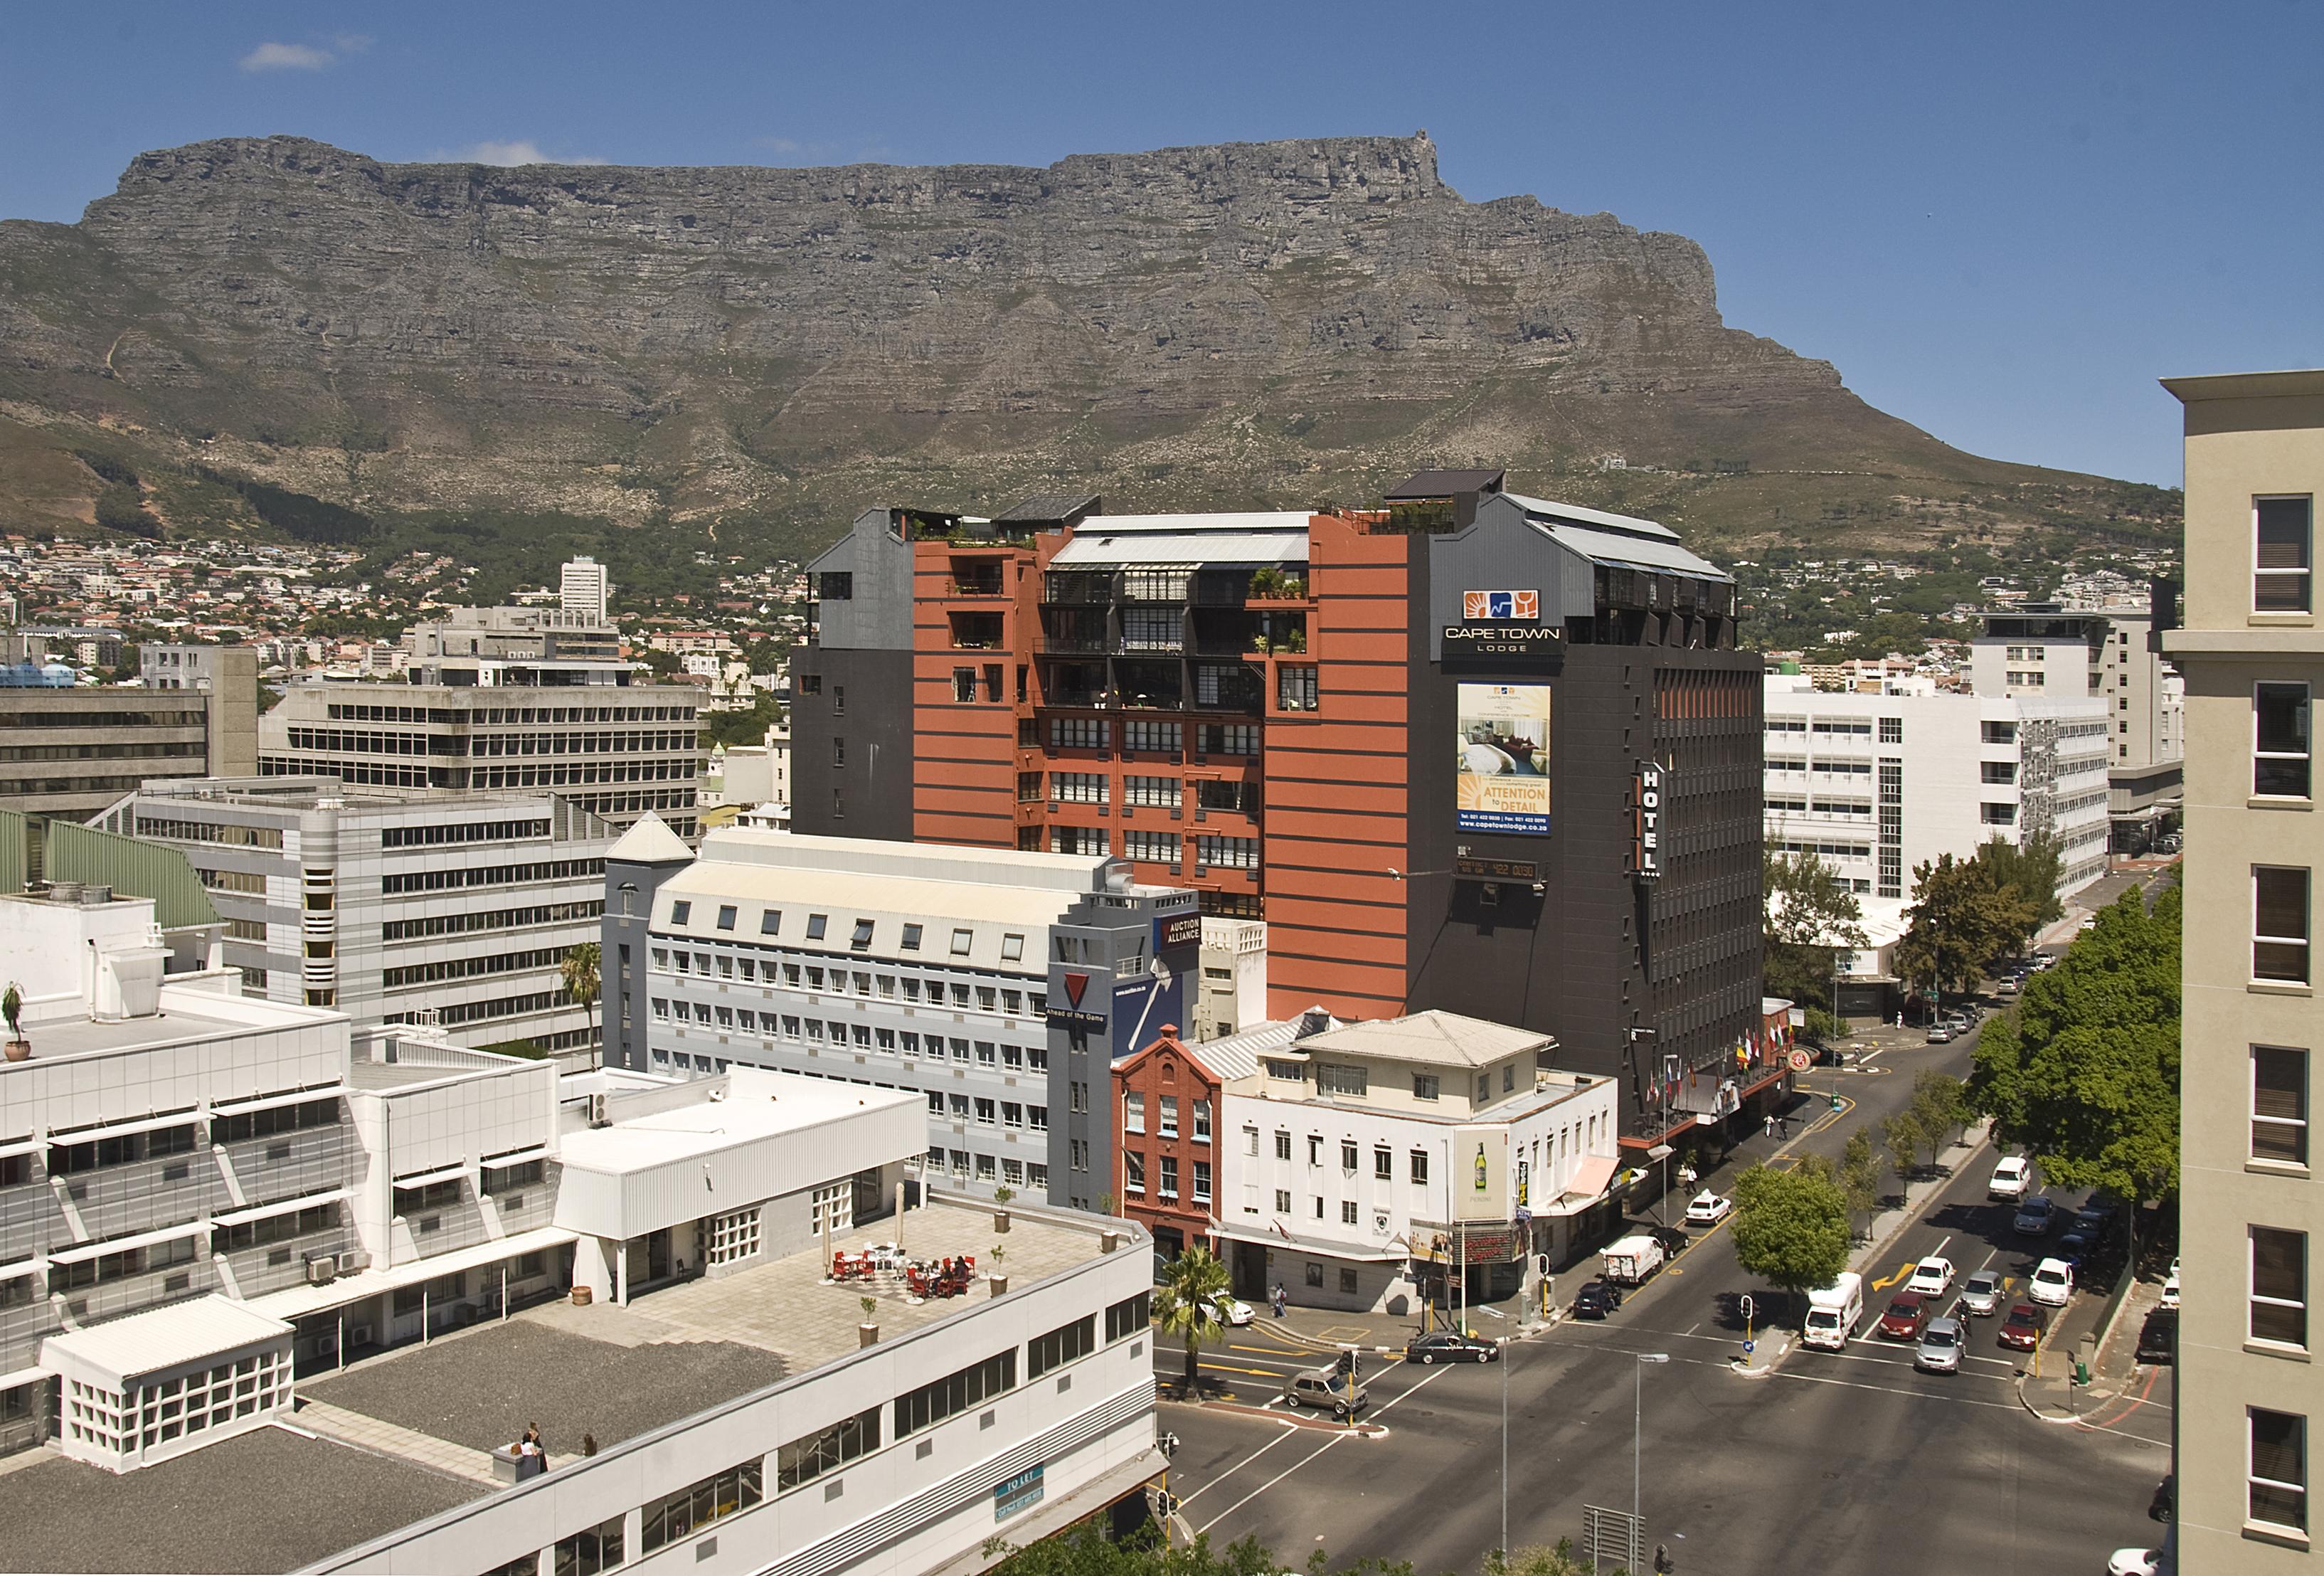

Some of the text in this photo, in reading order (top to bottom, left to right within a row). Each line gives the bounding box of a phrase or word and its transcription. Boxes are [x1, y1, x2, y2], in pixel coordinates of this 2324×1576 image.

[1445, 628, 1560, 640] CAPE TOWN
[1484, 787, 1545, 800] ATTENTION
[1501, 801, 1538, 813] DETAIL
[1460, 820, 1547, 831] www.capetownlodge.co.za
[1643, 771, 1658, 869] HOTEL
[1493, 864, 1509, 875] 422
[1170, 918, 1199, 932] AUCTION
[1167, 929, 1200, 943] ALLIANCE
[1046, 1008, 1066, 1017] Ahead
[1086, 1013, 1104, 1022] Game
[1007, 1471, 1034, 1491] TO LET
